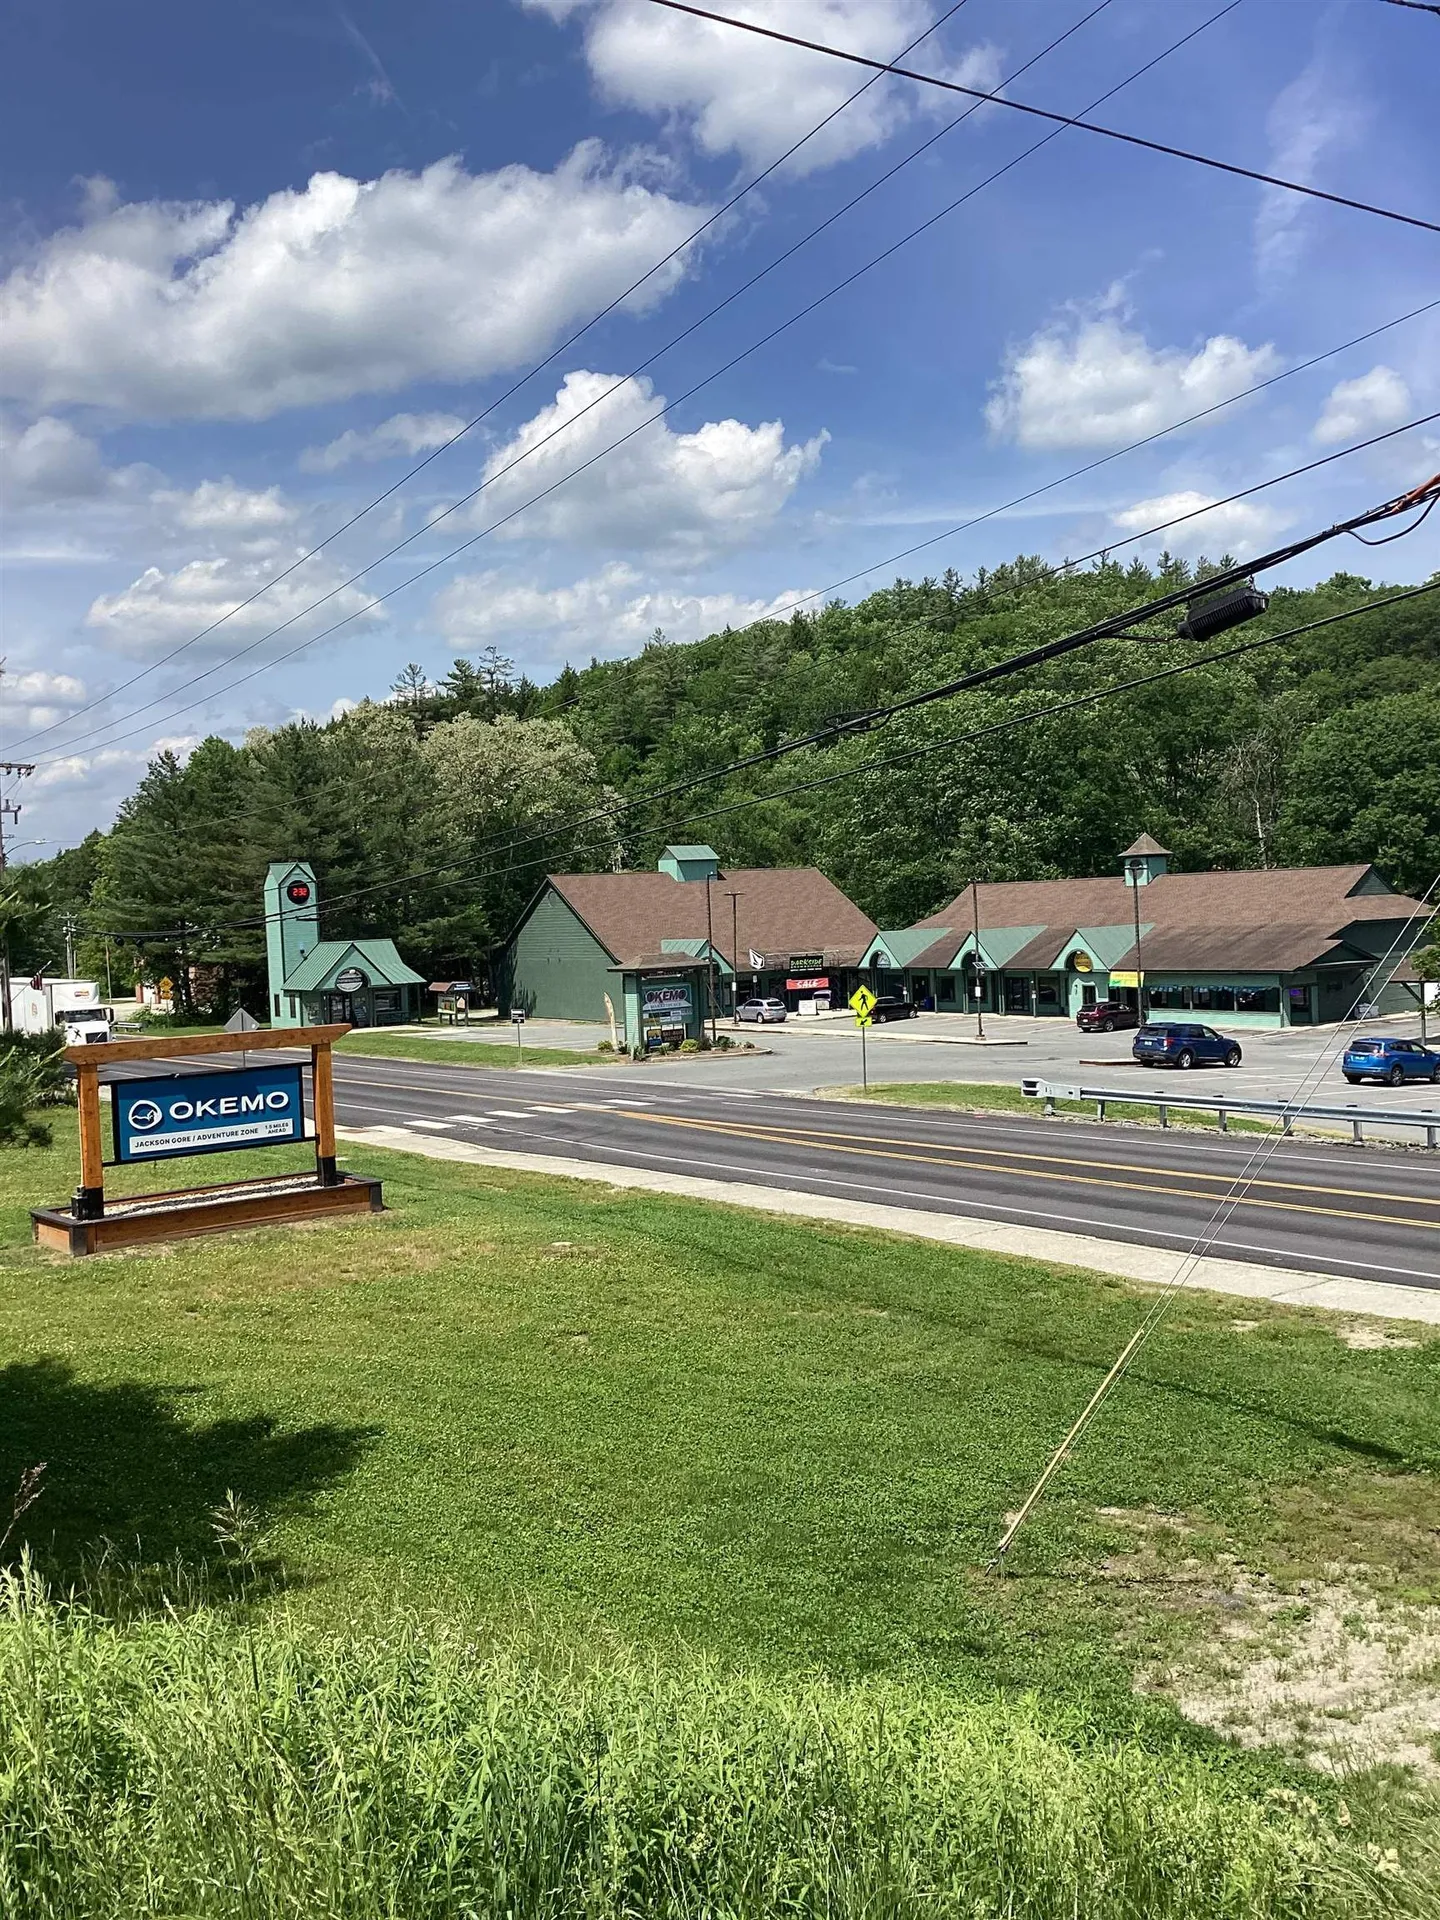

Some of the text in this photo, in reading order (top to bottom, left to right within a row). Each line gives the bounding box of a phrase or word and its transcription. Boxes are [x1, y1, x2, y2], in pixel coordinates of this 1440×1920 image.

[797, 979, 819, 989] SALE
[646, 988, 687, 1003] OKEMO
[169, 1091, 289, 1120] OKEMO
[135, 1138, 170, 1148] JACKSON
[171, 1135, 192, 1144] GORE
[196, 1130, 239, 1141] ADVENTURE
[240, 1127, 259, 1136] ZONE
[267, 1127, 287, 1135] AHEAD
